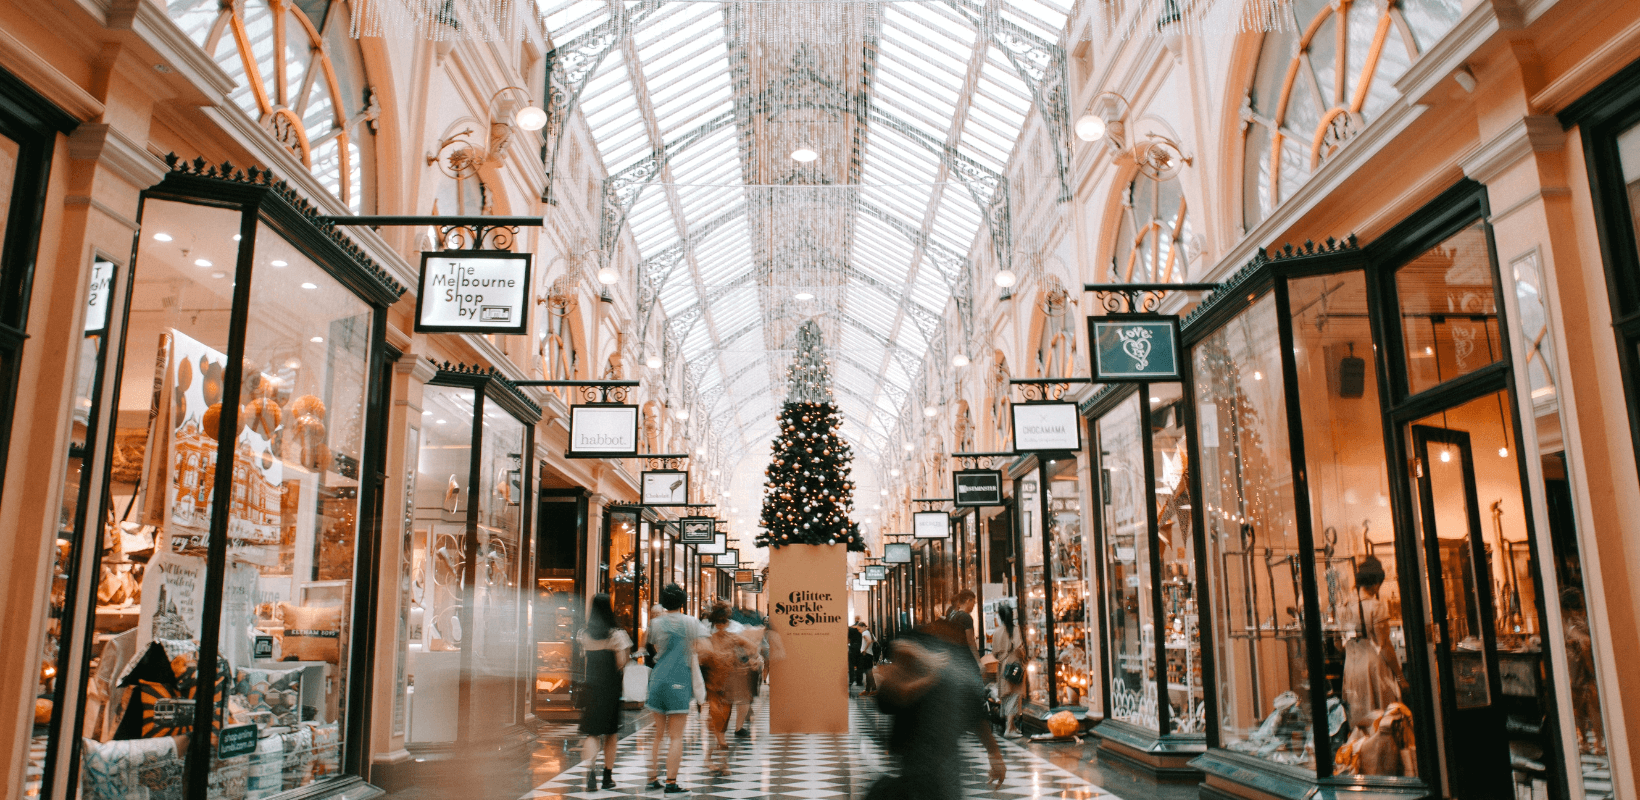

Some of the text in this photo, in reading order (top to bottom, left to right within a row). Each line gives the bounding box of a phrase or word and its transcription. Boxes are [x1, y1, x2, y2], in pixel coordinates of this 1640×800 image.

[449, 263, 475, 275] The
[432, 274, 515, 287] Melbourne
[445, 289, 483, 306] Shop
[459, 306, 477, 319] by
[1022, 426, 1066, 434] CHOCAMAMA
[581, 433, 626, 445] habbot.
[789, 590, 832, 603] Glitter.
[775, 602, 823, 615] Sparkle
